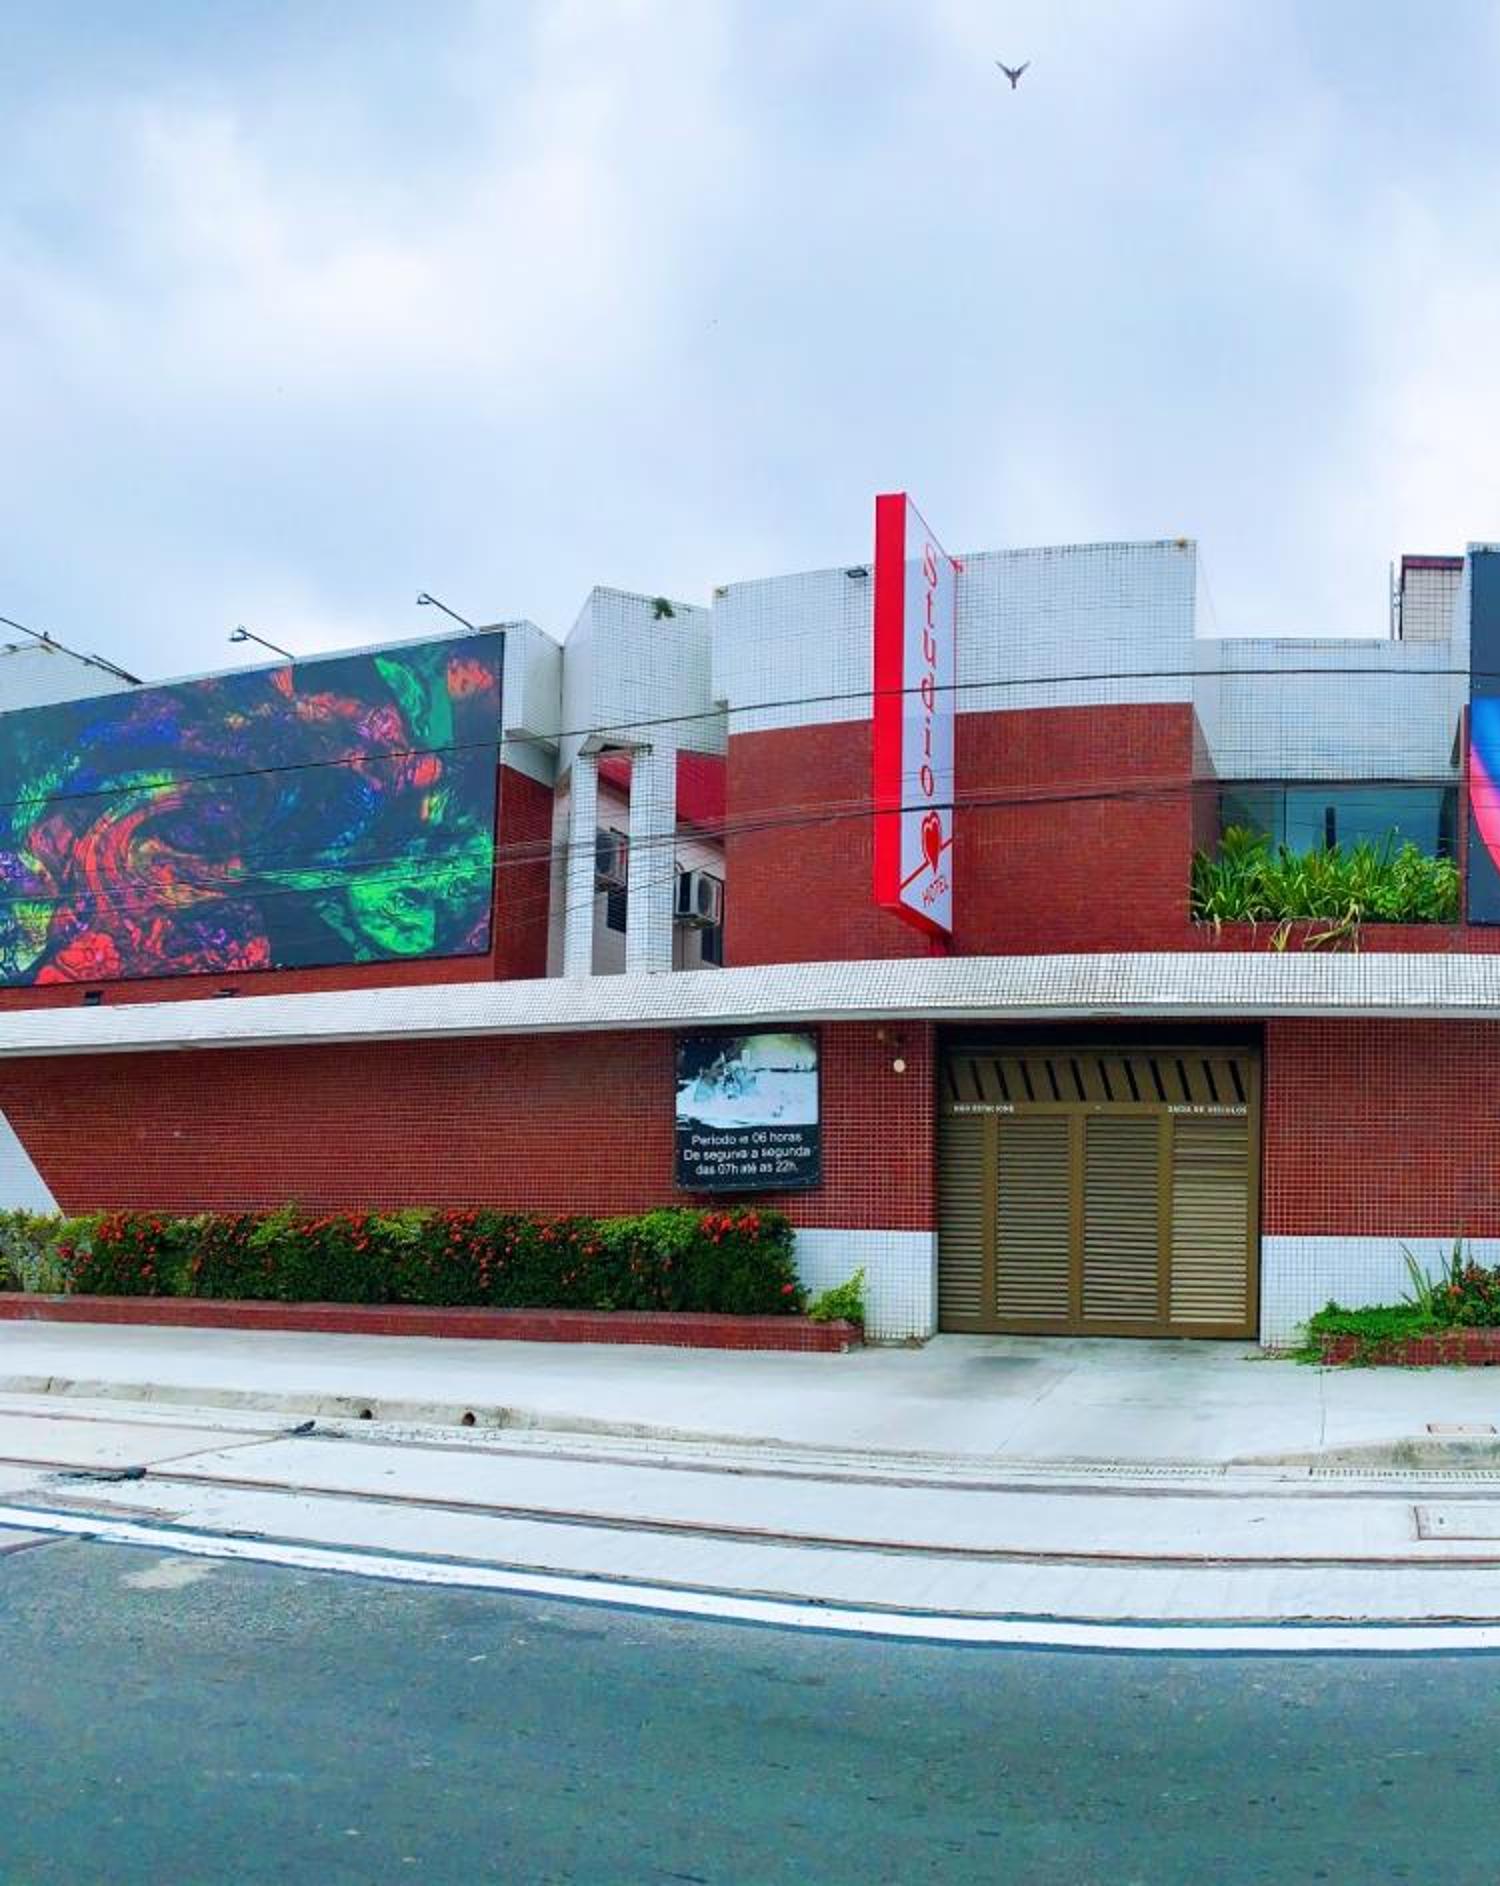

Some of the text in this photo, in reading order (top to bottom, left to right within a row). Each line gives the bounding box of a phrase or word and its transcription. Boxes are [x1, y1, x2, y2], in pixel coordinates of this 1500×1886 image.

[920, 544, 937, 797] Studio
[752, 1131, 767, 1144] 06
[769, 1131, 802, 1143] horas
[683, 1149, 700, 1161] De
[761, 1146, 811, 1159] segunda
[696, 1163, 716, 1175] das
[718, 1163, 739, 1175] 07h
